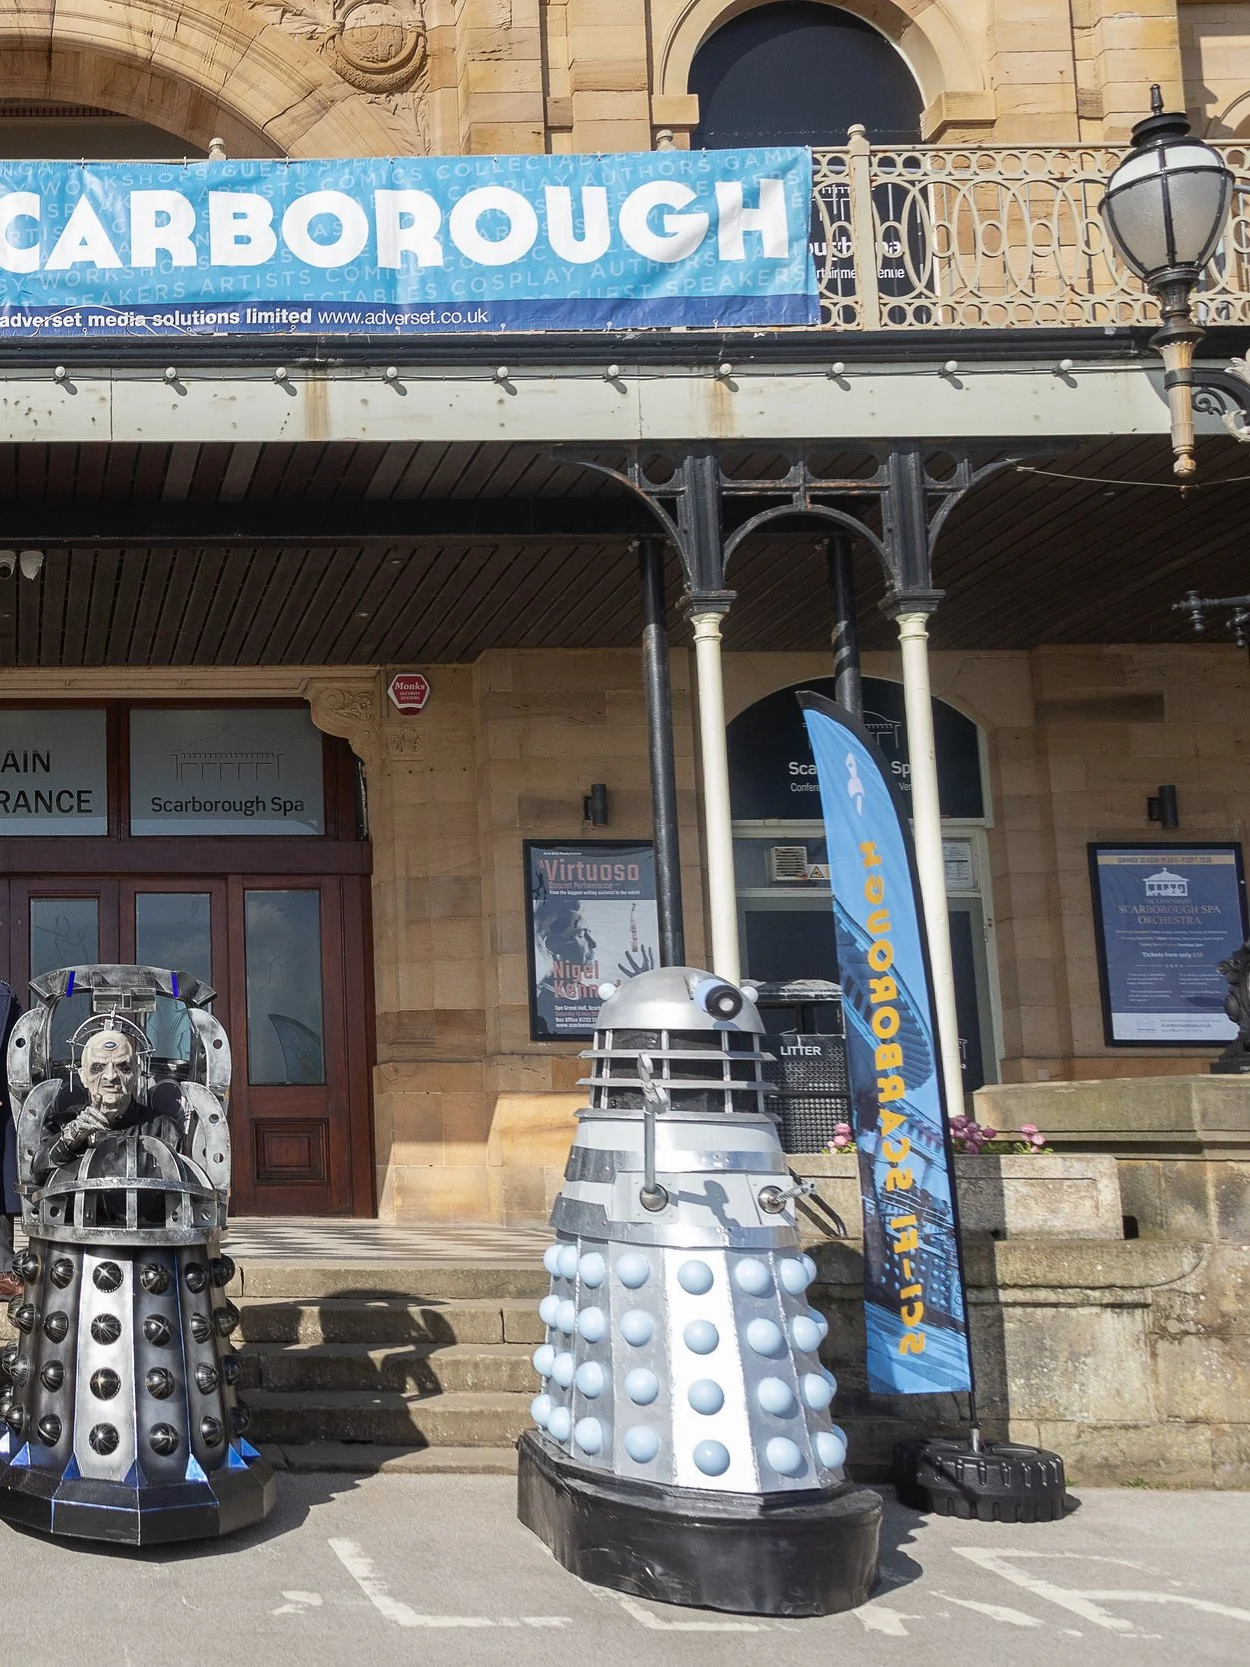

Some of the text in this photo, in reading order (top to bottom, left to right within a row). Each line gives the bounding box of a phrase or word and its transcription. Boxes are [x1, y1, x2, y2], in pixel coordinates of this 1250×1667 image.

[88, 309, 146, 328] media
[152, 308, 241, 328] solutions
[246, 307, 312, 326] limited
[318, 306, 490, 328] www.adverset.co.uk
[394, 681, 426, 690] Monks
[150, 795, 305, 818] Scarborough Spa
[543, 858, 640, 881] Virtuoso
[1118, 904, 1221, 914] SCARBOROUGH SPA
[1137, 915, 1202, 925] ORCHESTRA
[1178, 951, 1192, 959] only
[553, 959, 599, 983] Nigel
[780, 1045, 822, 1056] LITTER
